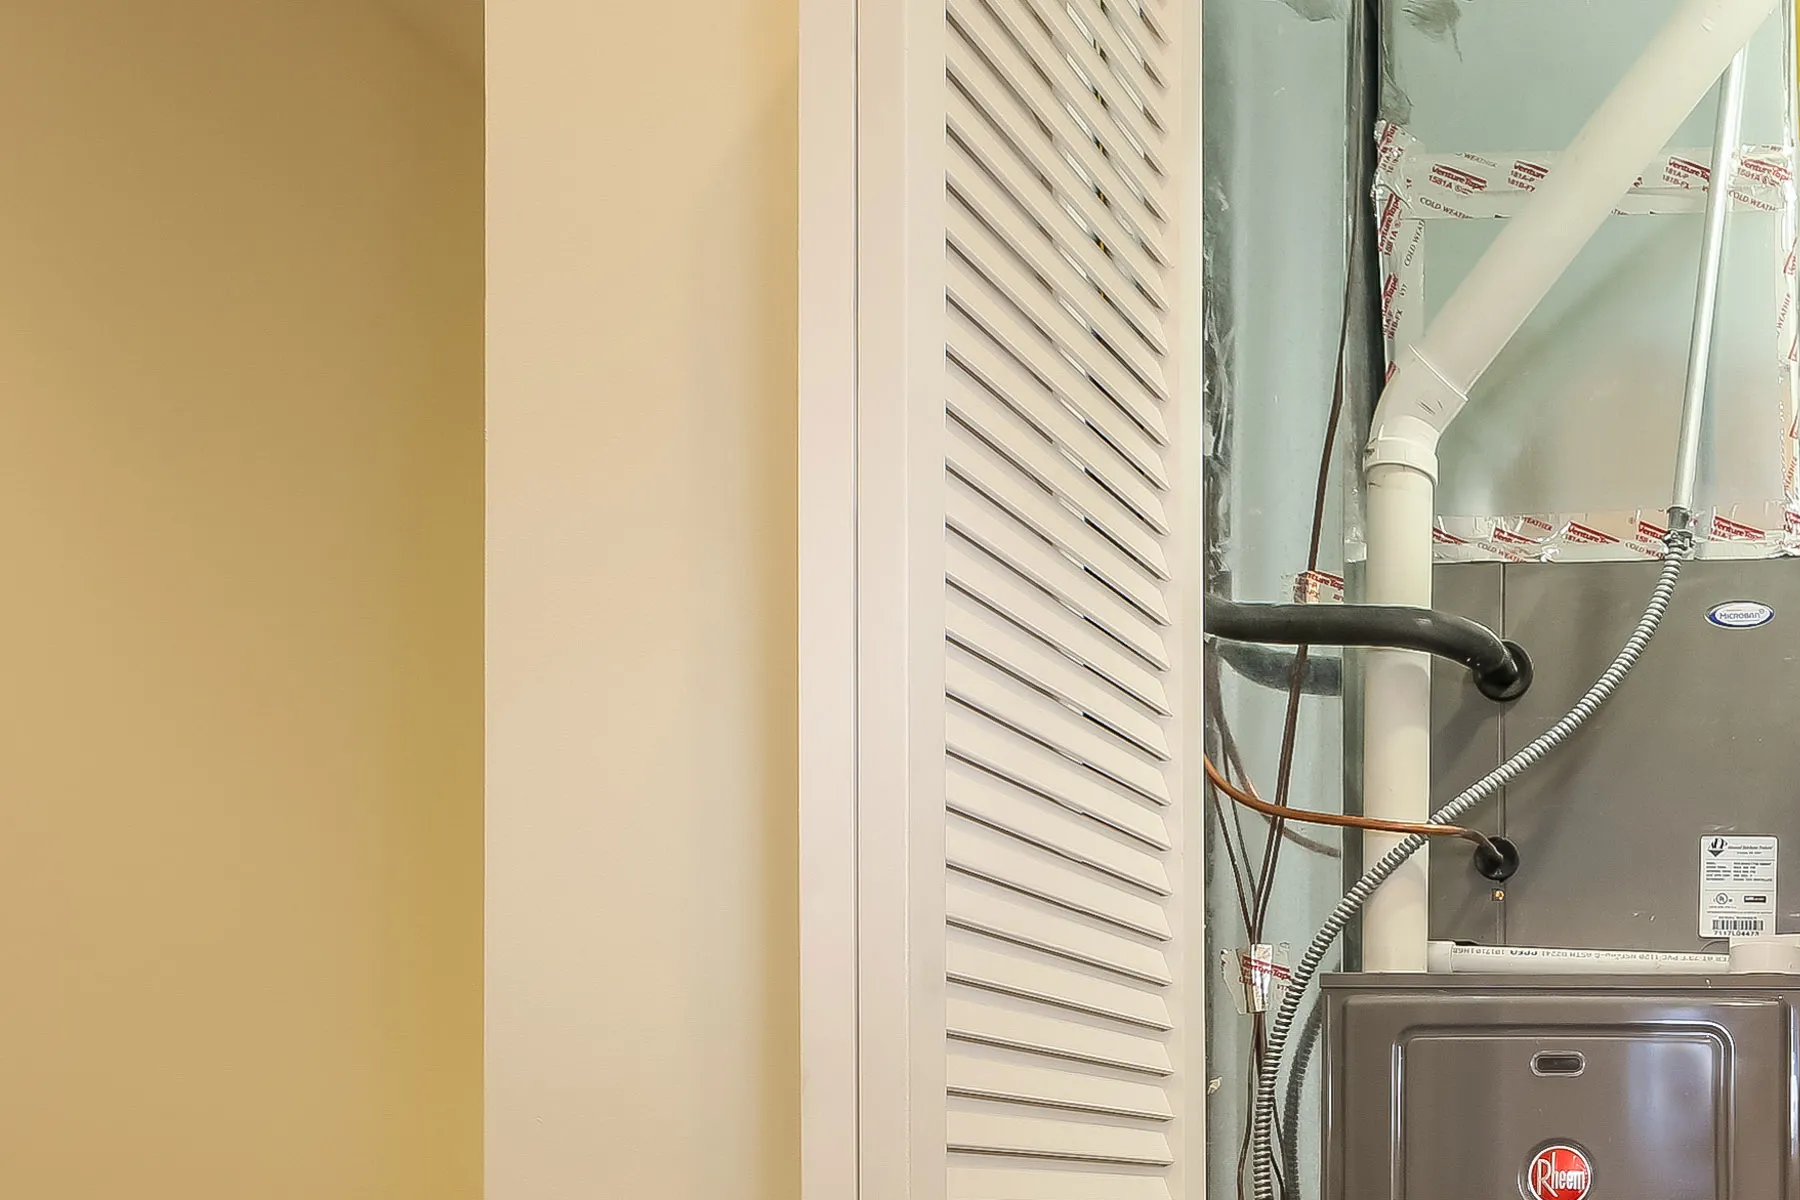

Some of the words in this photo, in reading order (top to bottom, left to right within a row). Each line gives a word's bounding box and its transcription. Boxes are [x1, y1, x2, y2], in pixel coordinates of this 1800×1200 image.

[1428, 174, 1453, 190] 1581A
[1419, 196, 1442, 210] COLD
[1728, 189, 1750, 204] COLD
[1403, 243, 1418, 268] COLD
[1478, 541, 1497, 554] COLD
[1625, 541, 1646, 553] COLD
[1536, 1151, 1585, 1198] Rheem
